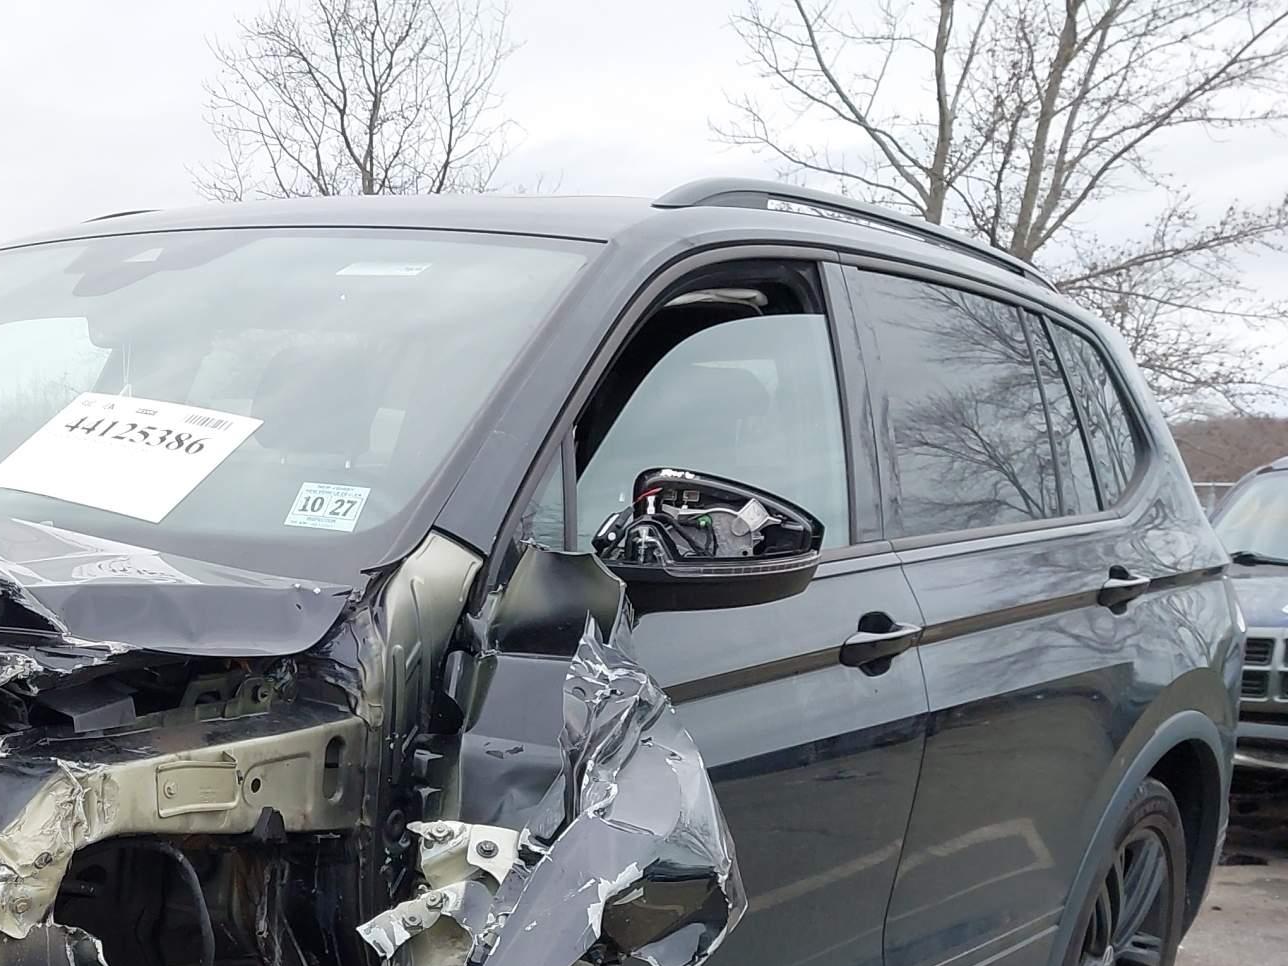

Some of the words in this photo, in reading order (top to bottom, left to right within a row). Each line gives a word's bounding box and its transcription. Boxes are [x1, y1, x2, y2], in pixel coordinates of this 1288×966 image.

[64, 416, 213, 455] 44125386
[297, 495, 325, 513] 10
[328, 498, 358, 517] 27
